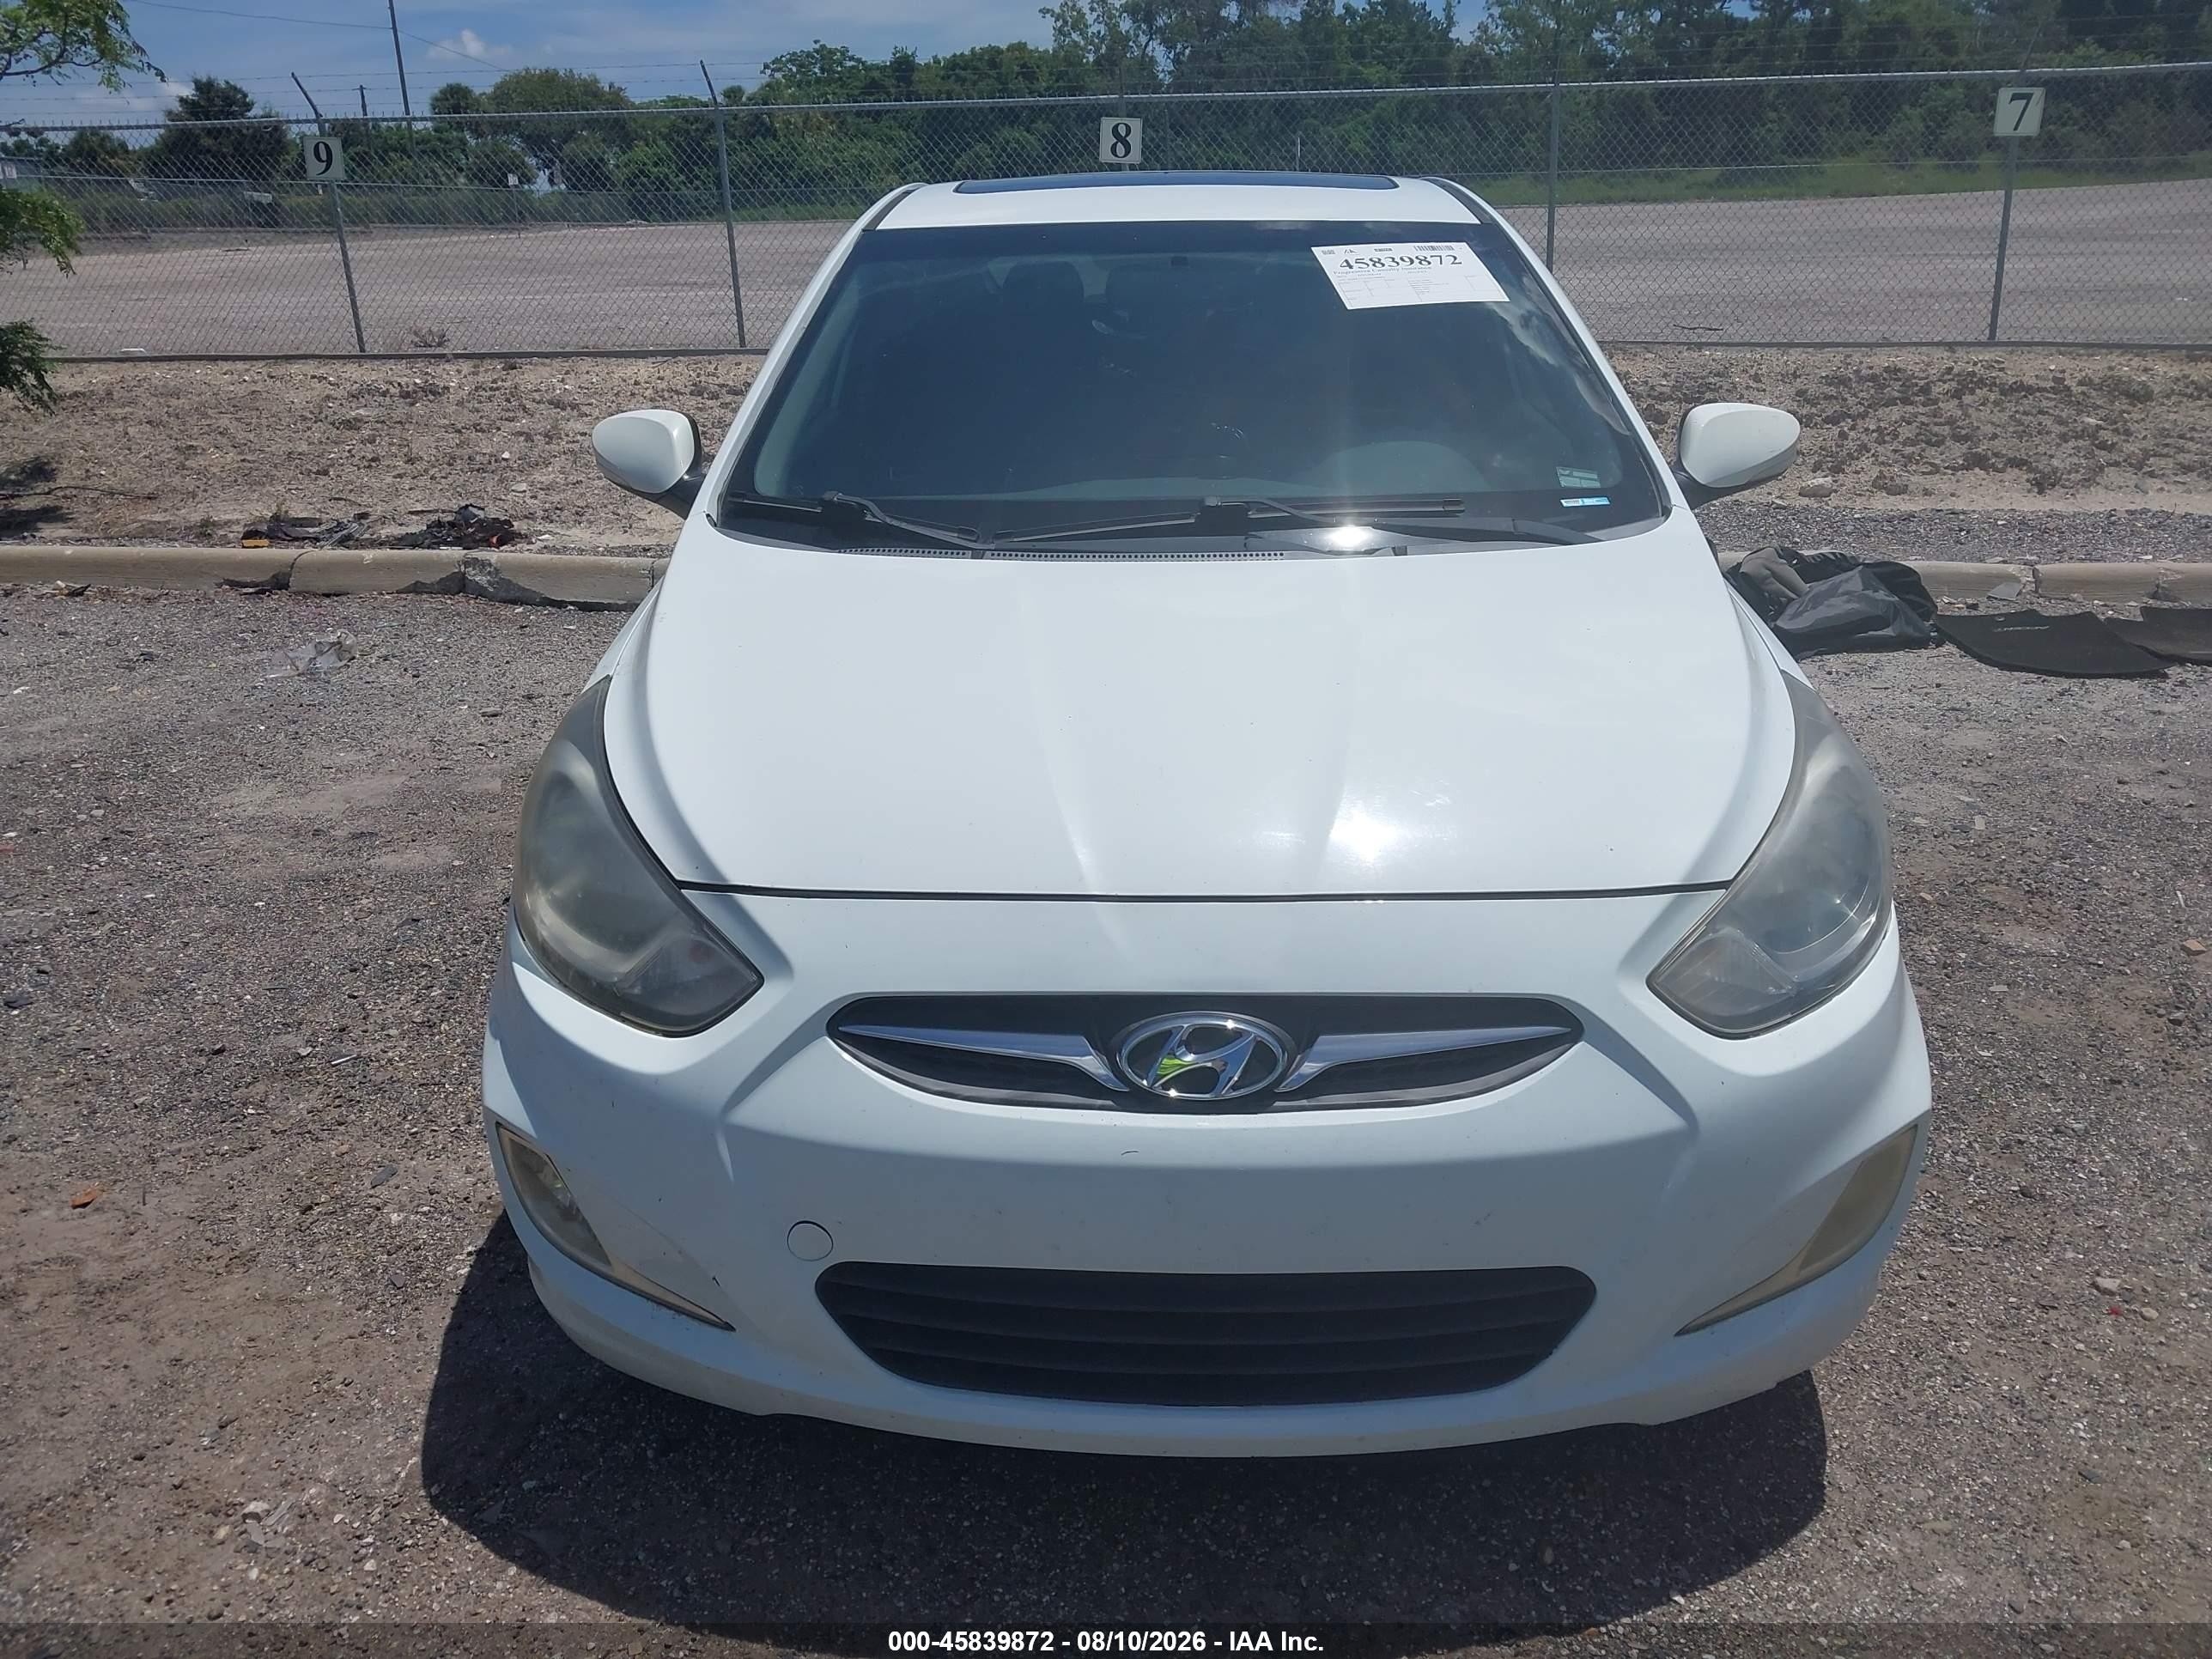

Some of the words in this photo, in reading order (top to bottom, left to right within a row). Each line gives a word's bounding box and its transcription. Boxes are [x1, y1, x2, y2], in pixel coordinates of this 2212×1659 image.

[2008, 92, 2034, 131] 7
[313, 141, 333, 176] 9
[1110, 122, 1132, 159] 8
[1340, 254, 1462, 270] 45839872
